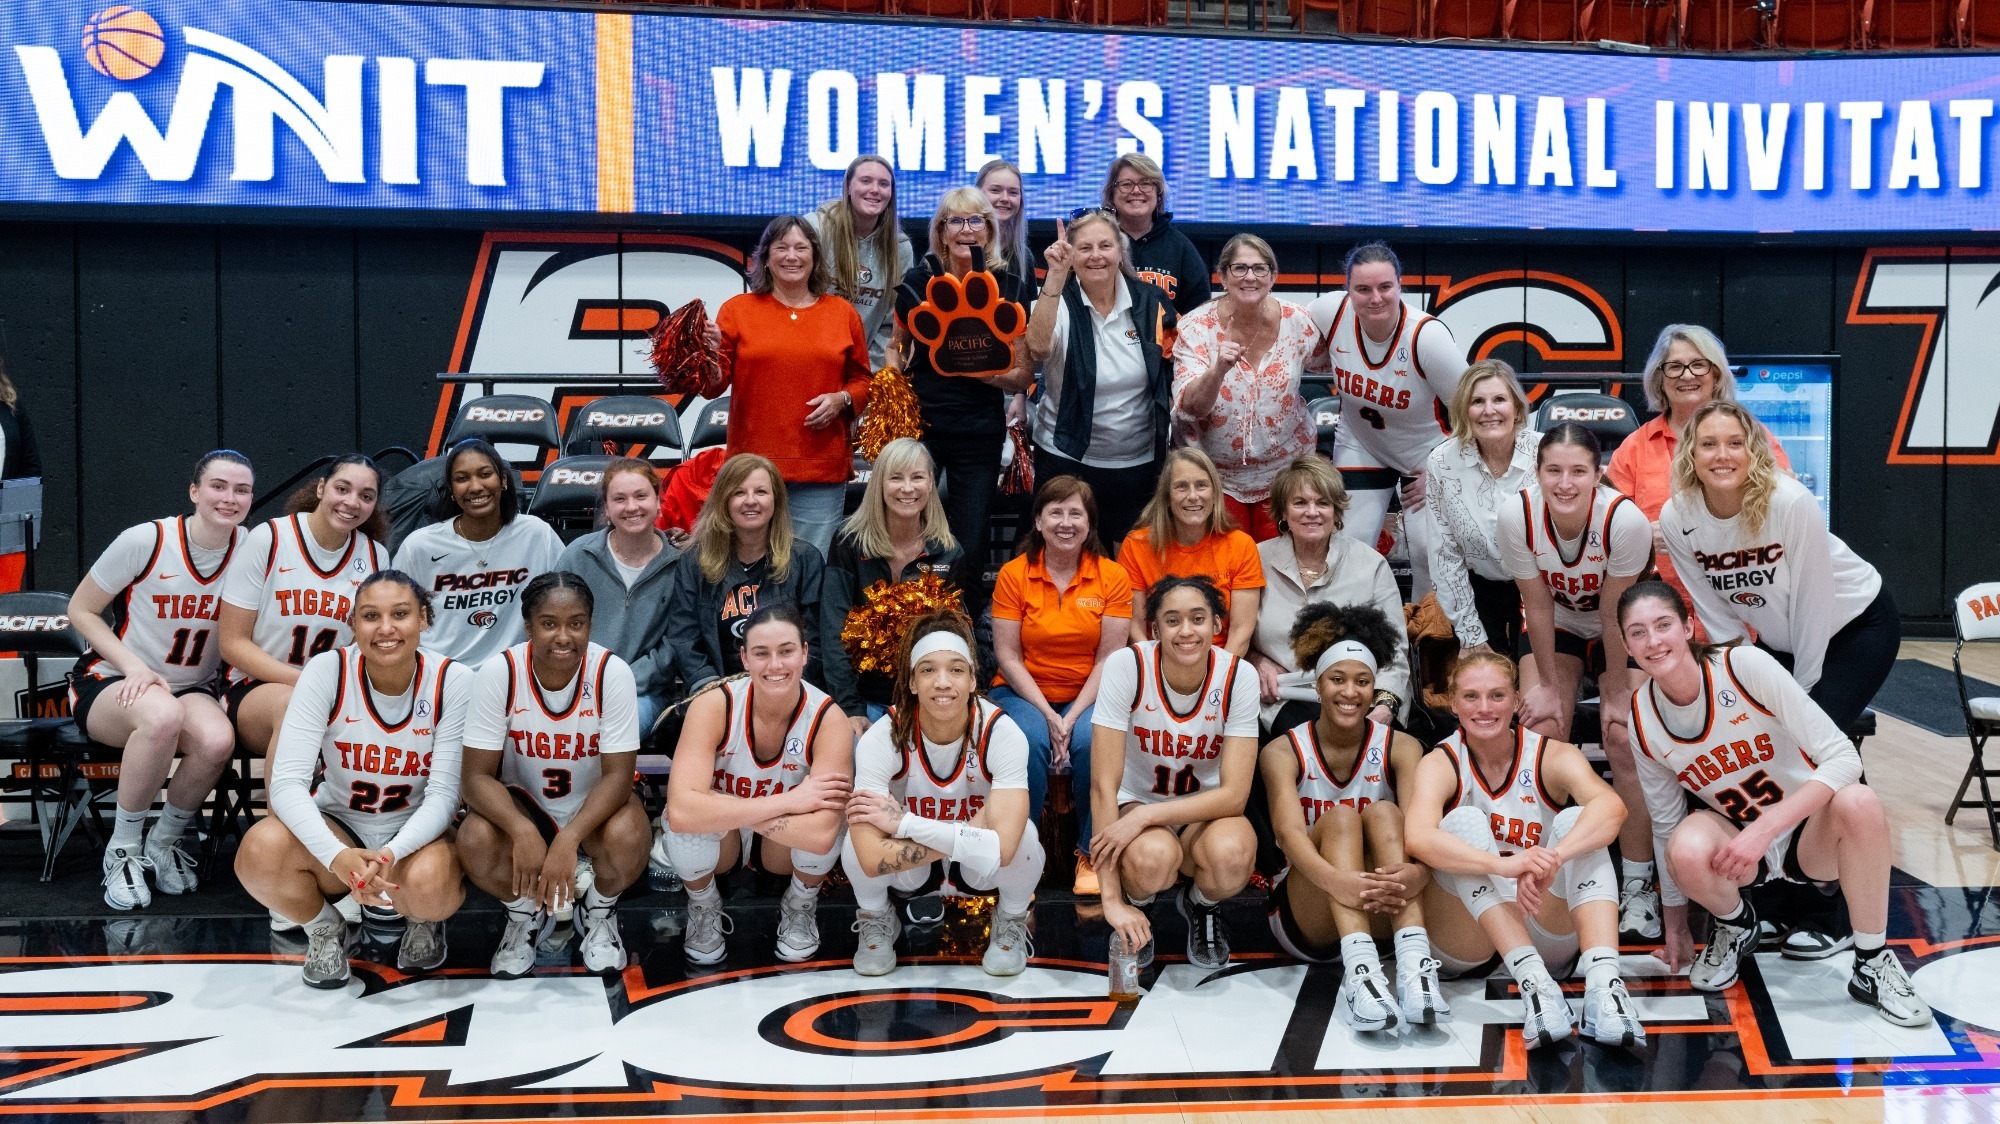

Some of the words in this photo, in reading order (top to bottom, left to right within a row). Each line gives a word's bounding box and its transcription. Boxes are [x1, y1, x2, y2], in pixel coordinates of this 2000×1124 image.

[14, 25, 546, 187] WNIT
[1209, 84, 1618, 188] NATIONAL
[1655, 98, 1993, 191] INVITAT
[948, 336, 993, 350] PACIFIC
[1335, 366, 1411, 410] TIGERS
[1772, 370, 1803, 380] pepsi
[465, 406, 545, 423] PACIFIC
[587, 411, 666, 428] PACIFIC
[1550, 405, 1626, 421] PACIFIC
[434, 567, 529, 592] PACIFIC
[443, 587, 520, 610] ENERGY
[1076, 599, 1105, 608] PACIFIC
[165, 627, 210, 667] 11
[287, 624, 339, 667] 14
[412, 728, 432, 736] WCC
[508, 729, 601, 761] TIGERS
[1134, 725, 1225, 759] TIGERS
[1677, 732, 1775, 792] TIGERS
[542, 767, 572, 799] 3
[1151, 763, 1201, 797] 10
[1714, 768, 1785, 823] 25
[349, 779, 413, 814] 22
